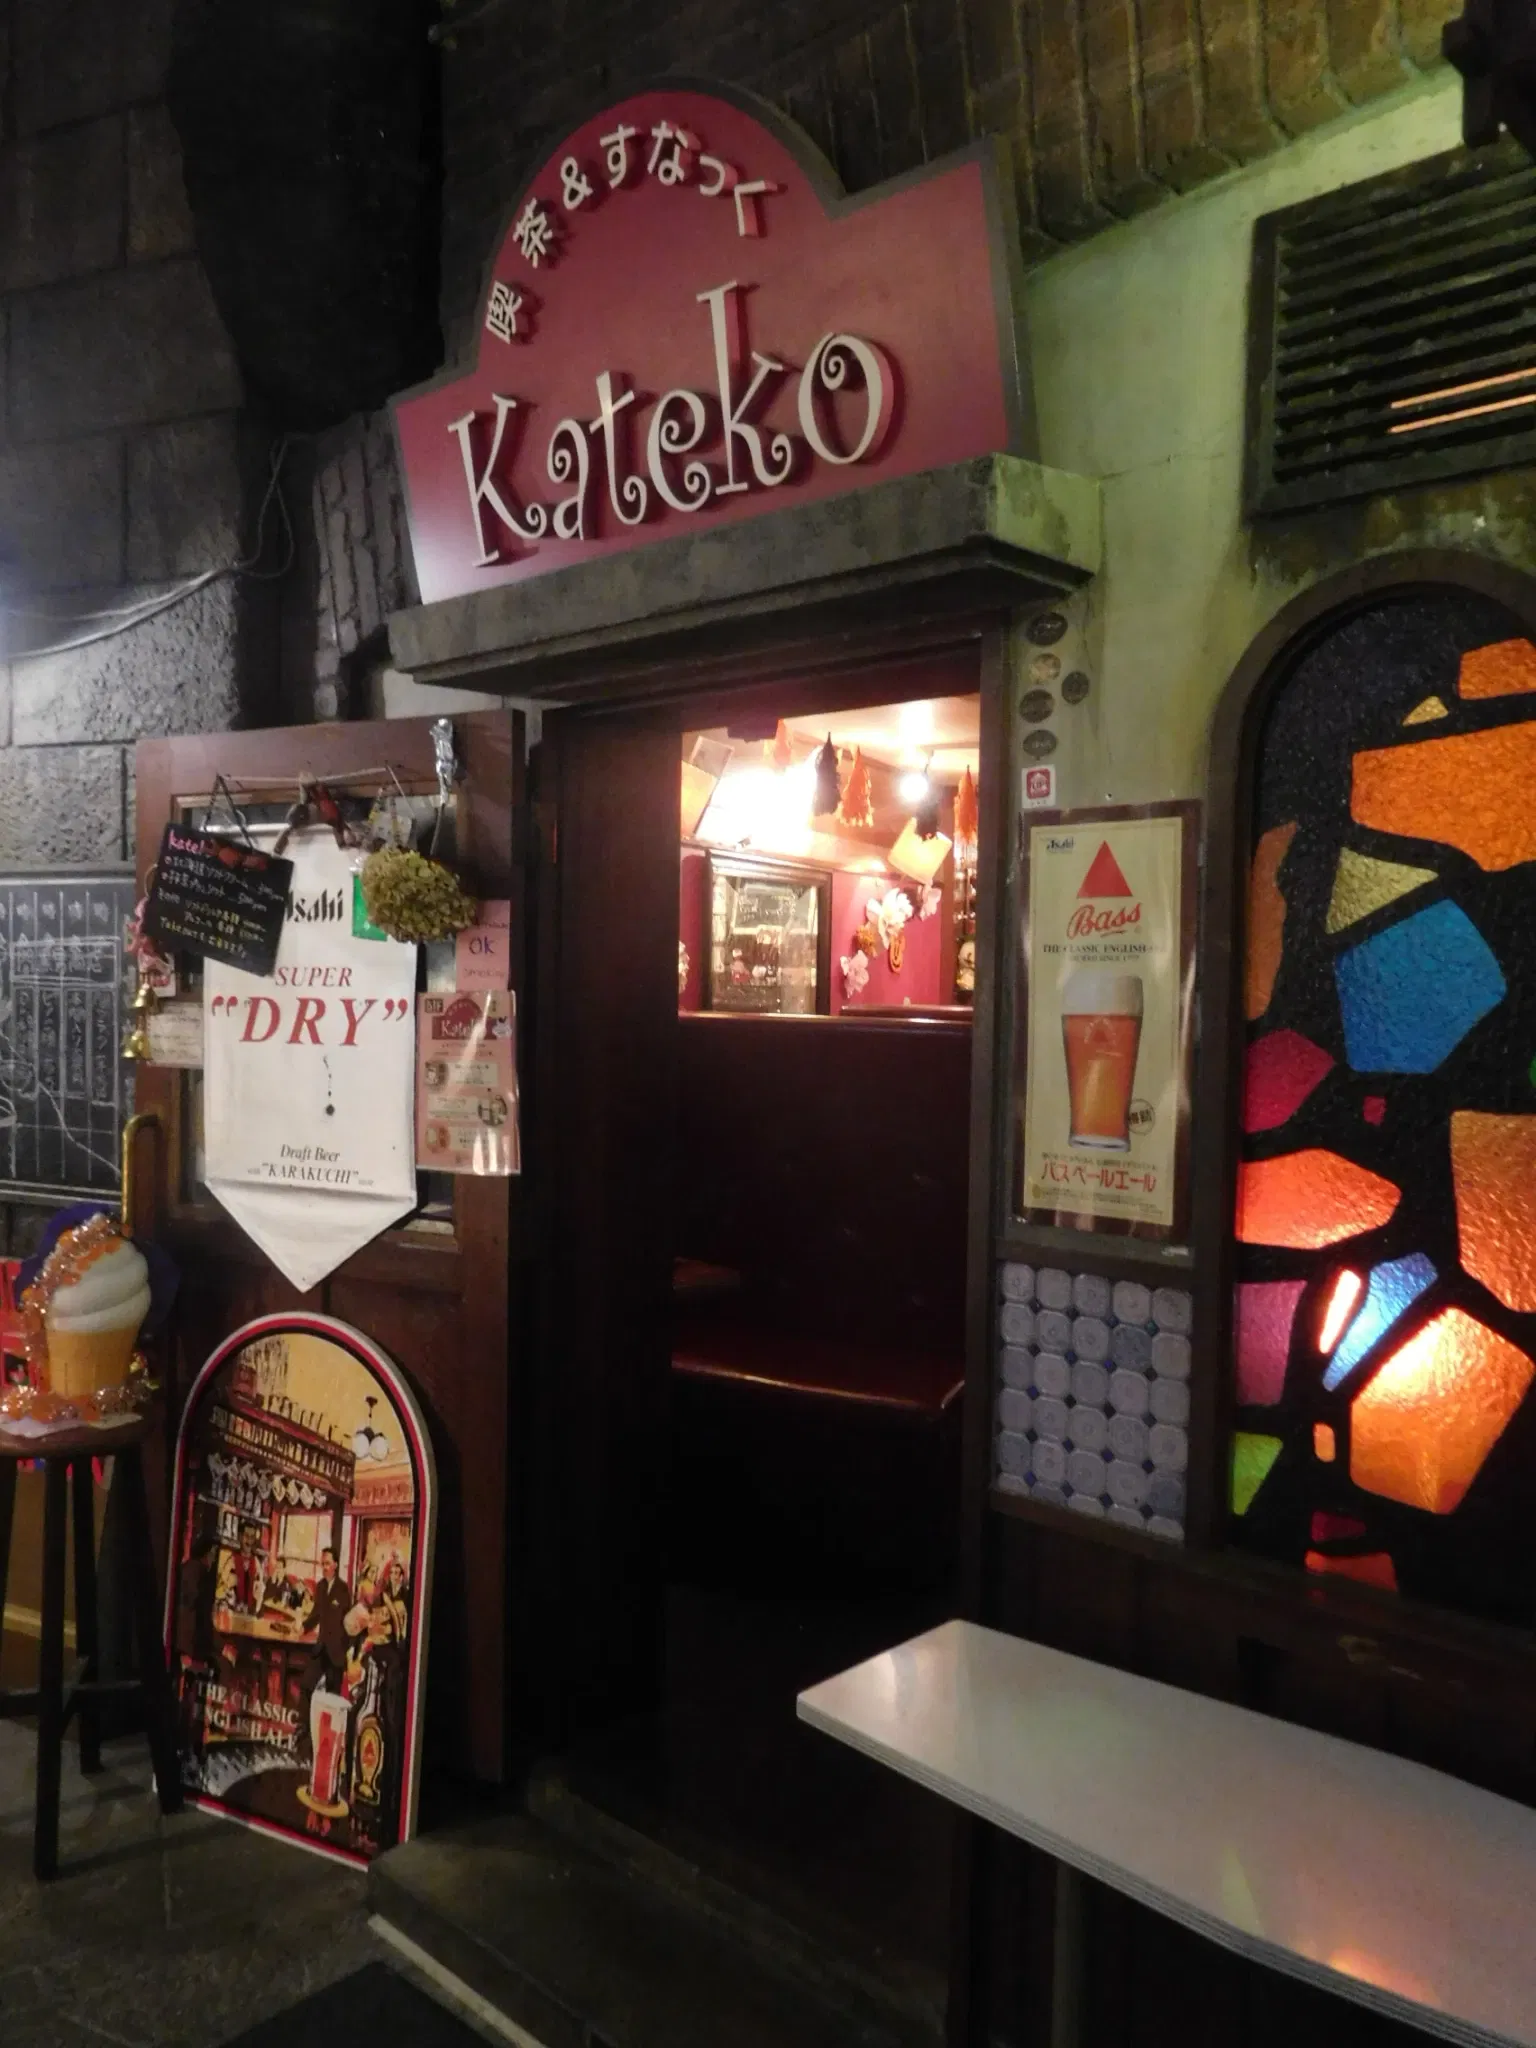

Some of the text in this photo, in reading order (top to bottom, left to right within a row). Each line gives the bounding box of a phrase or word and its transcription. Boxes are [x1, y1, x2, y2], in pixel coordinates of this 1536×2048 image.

[448, 280, 893, 568] Kateko
[1066, 903, 1143, 940] Bass
[275, 966, 353, 988] SUPER
[280, 1144, 341, 1162] Draft Beer
[231, 1690, 300, 1727] CLASSIC
